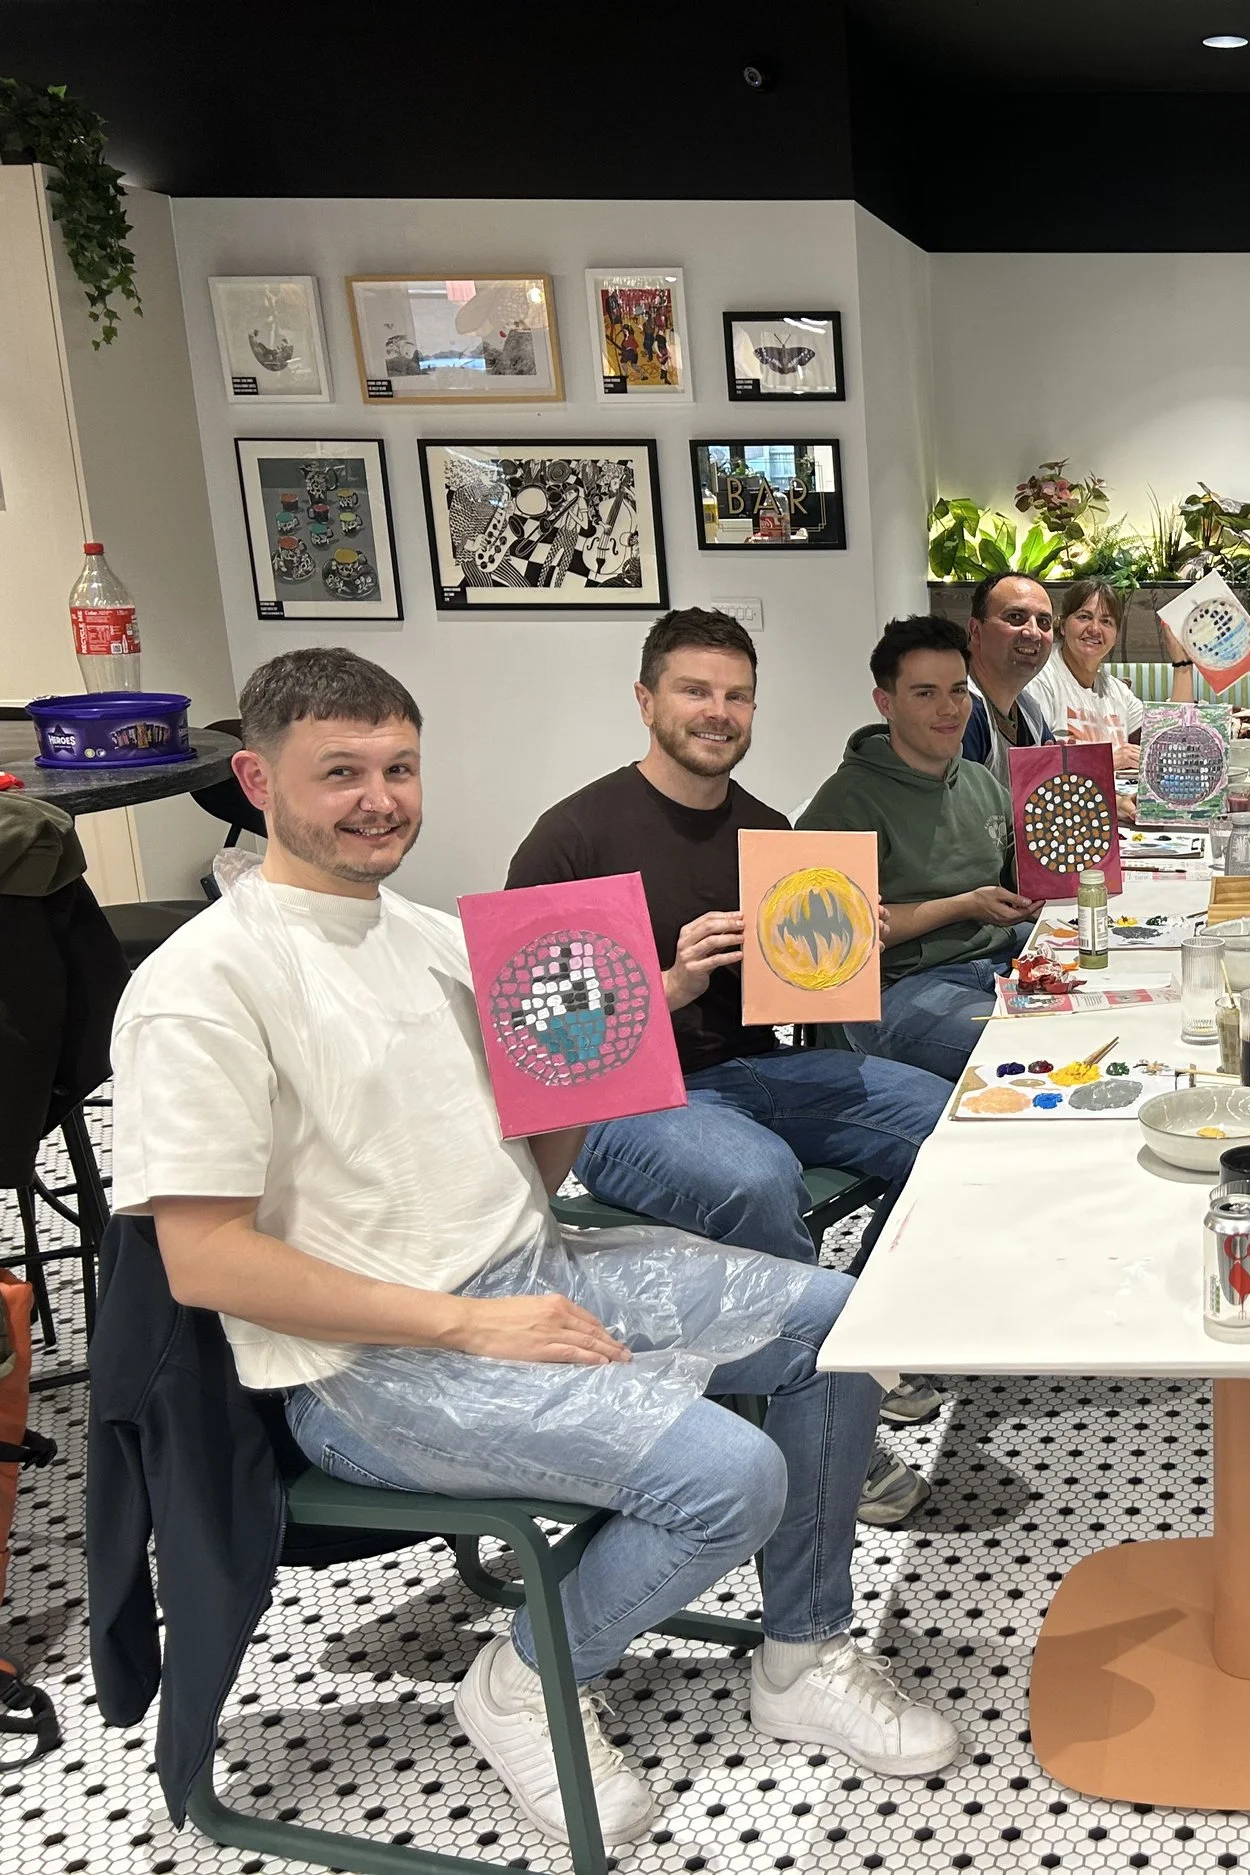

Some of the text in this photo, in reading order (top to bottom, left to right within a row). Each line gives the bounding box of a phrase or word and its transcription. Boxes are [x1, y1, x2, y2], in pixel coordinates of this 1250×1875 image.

[726, 476, 808, 514] BAR
[79, 623, 88, 653] RECYCLE
[48, 735, 76, 745] HEROES
